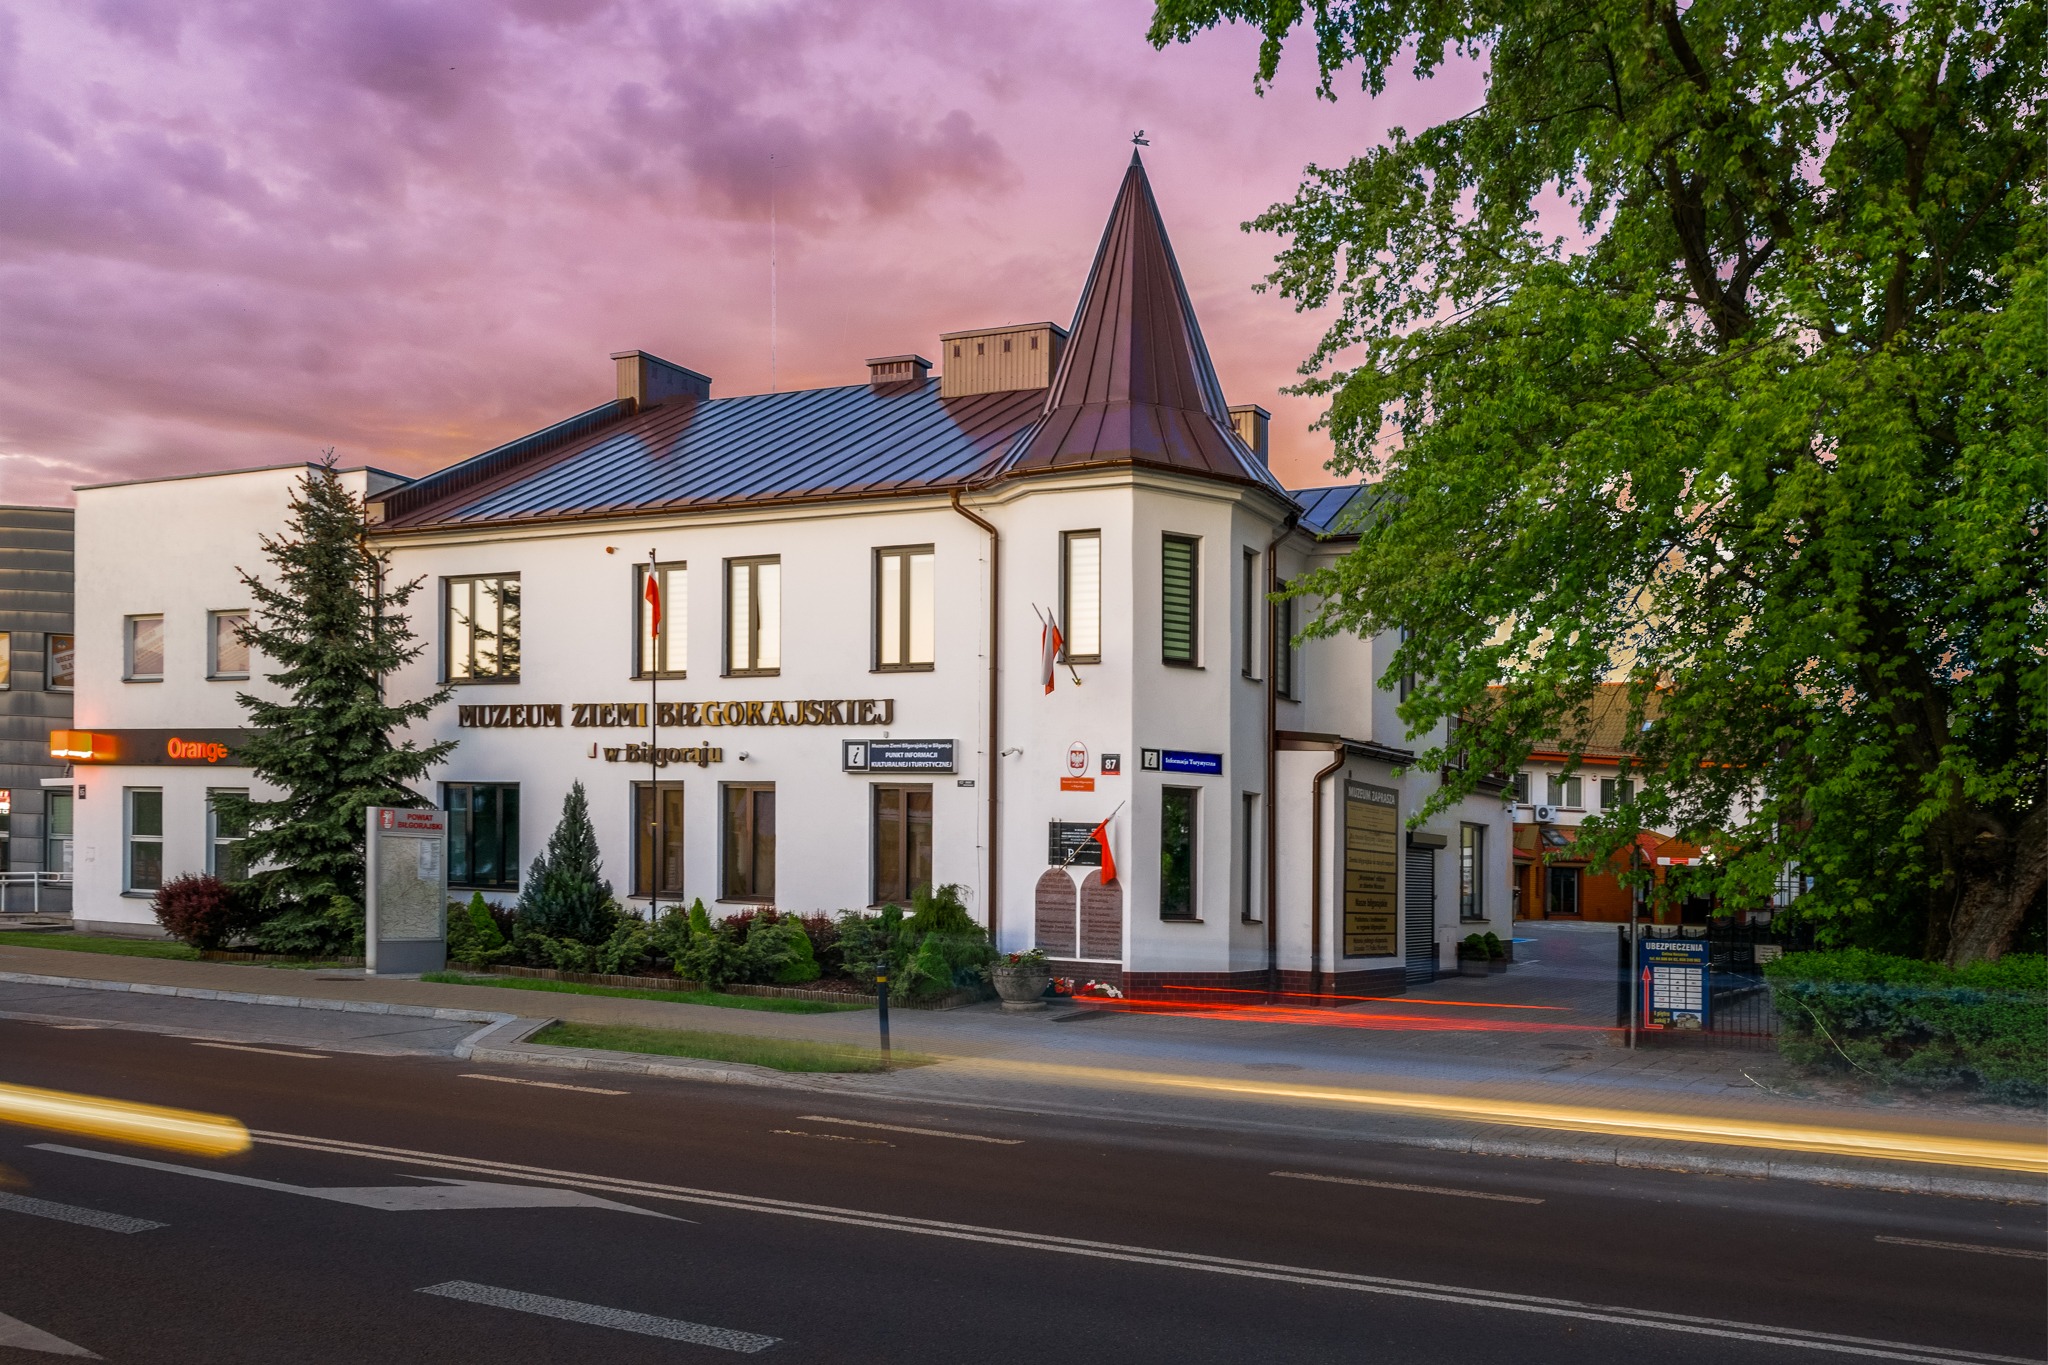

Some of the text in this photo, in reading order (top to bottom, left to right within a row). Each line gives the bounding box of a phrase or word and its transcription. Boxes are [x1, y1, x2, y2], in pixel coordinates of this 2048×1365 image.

[458, 699, 895, 728] MUZEUM ZIEMI BIŁGORAJSKIEJ
[167, 737, 228, 763] Orange
[603, 741, 723, 768] w Biłgoraju
[1105, 759, 1117, 770] 87
[1165, 757, 1189, 765] Informacja
[1348, 786, 1396, 805] MUZEUM ZAPRASZA
[407, 814, 433, 822] POWIAT
[397, 822, 443, 830] BIŁGORAJSKI
[1645, 942, 1704, 952] UBEZPIECZENIA
